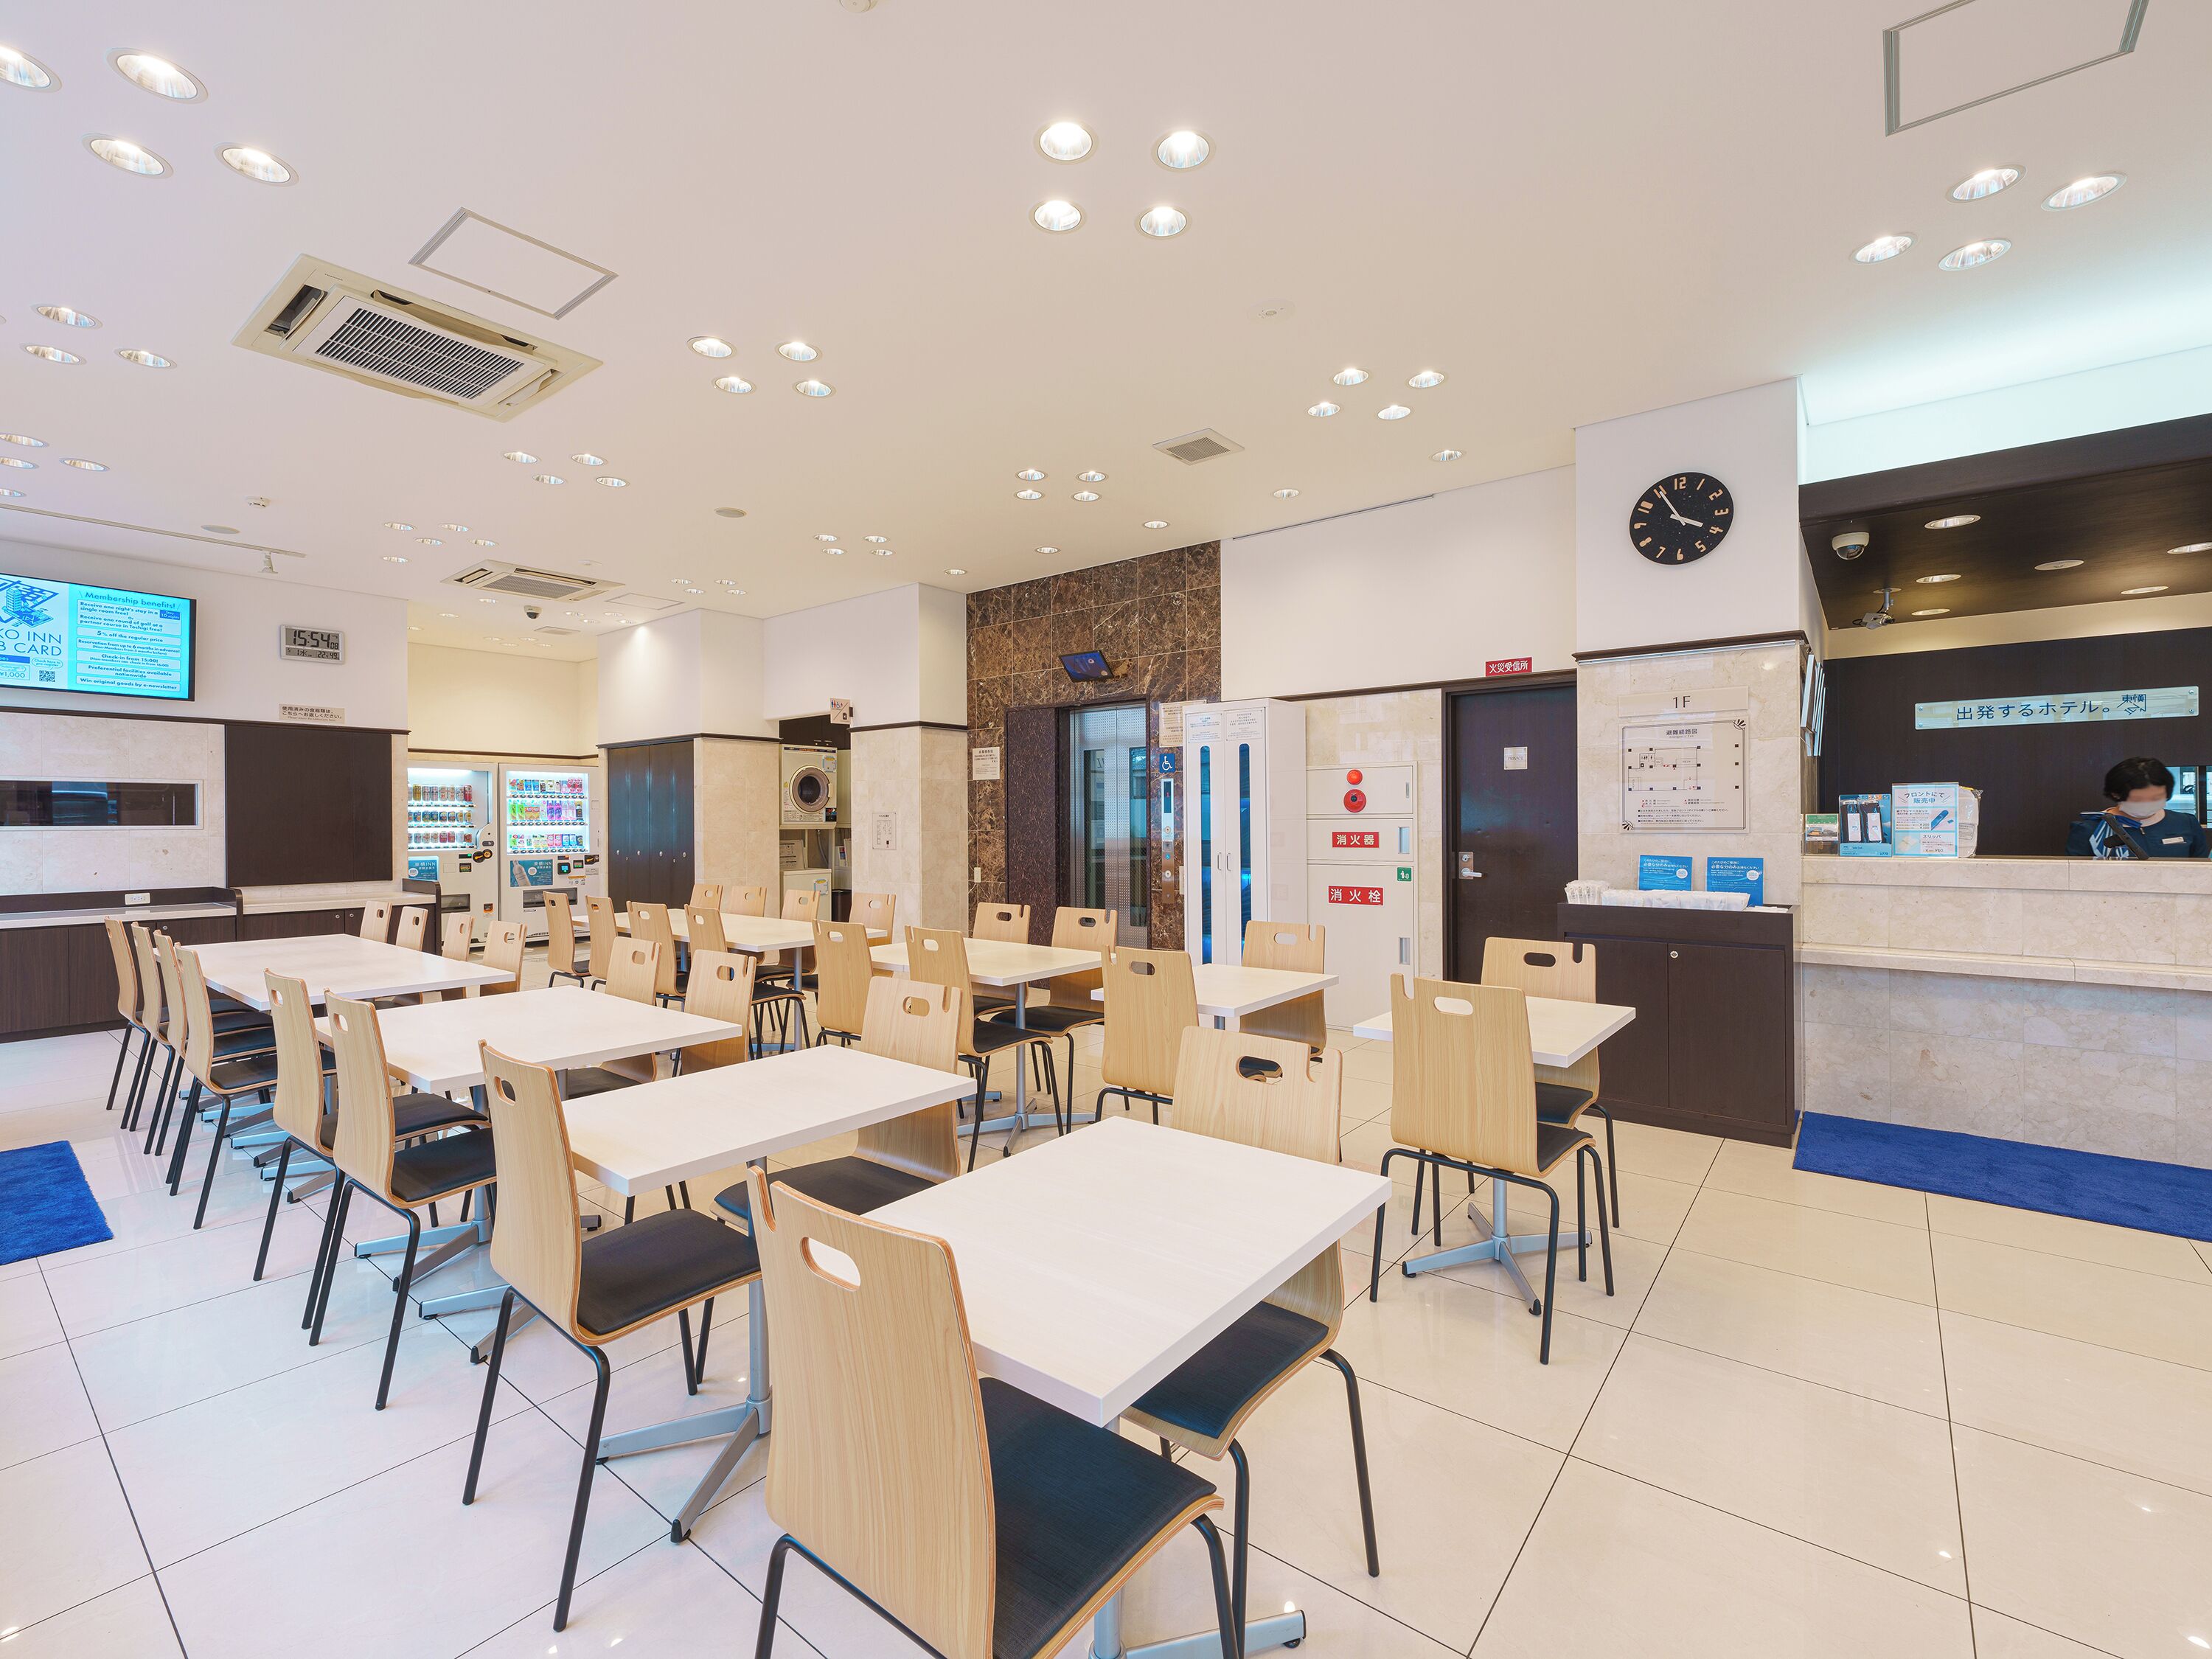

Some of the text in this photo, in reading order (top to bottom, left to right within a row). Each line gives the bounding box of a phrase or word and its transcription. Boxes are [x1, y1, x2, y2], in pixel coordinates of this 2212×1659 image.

[1674, 476, 1686, 490] 12
[1697, 478, 1705, 490] 1
[1653, 485, 1666, 498] 11
[1709, 489, 1723, 501] 2
[1638, 501, 1653, 513] 10
[1715, 508, 1728, 516] 3
[1640, 537, 1652, 547] 8
[1695, 540, 1706, 552] 5
[1656, 546, 1666, 558] 7
[1677, 549, 1683, 560] 6
[86, 592, 175, 609] Membership benefits!
[28, 631, 61, 644] INN
[293, 630, 330, 648] 15:54
[14, 643, 62, 655] CARD
[1489, 661, 1528, 674] 火災受信所
[1672, 696, 1691, 708] 1F
[1957, 700, 2110, 720] 出発するホテル。
[1337, 835, 1374, 845] 消火器
[1331, 888, 1380, 902] 消火栓
